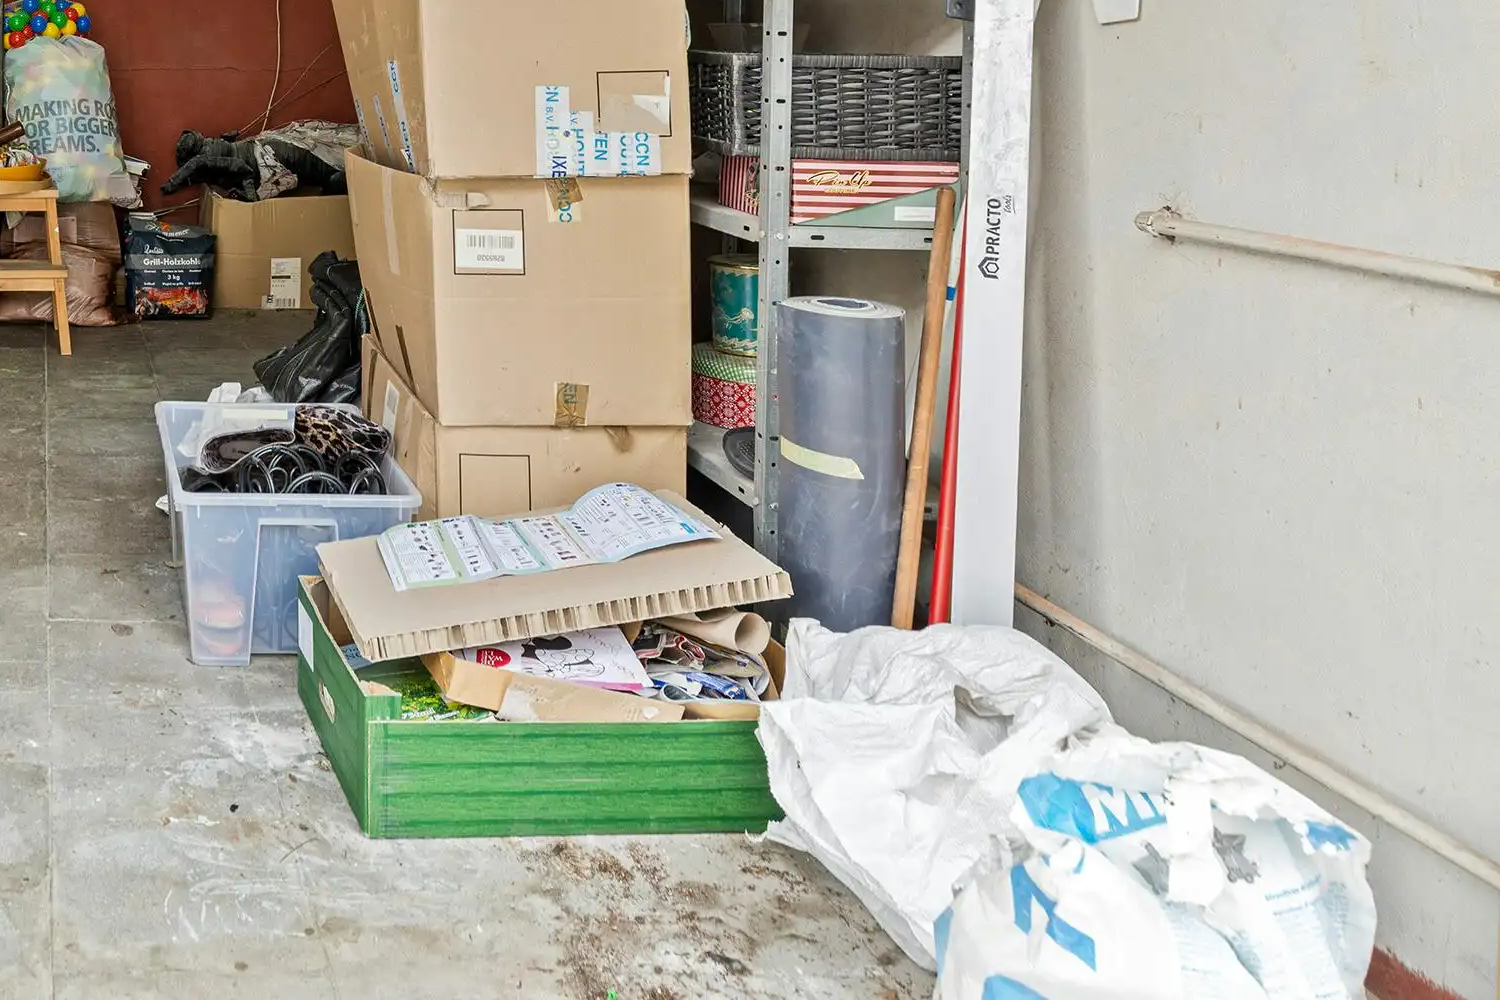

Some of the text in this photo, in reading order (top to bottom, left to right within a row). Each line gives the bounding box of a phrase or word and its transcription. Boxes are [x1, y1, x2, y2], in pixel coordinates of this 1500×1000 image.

[16, 98, 88, 121] MAKING
[25, 116, 116, 139] OR BIGGER
[30, 135, 100, 155] REAMS.
[985, 198, 1001, 255] PRACTO
